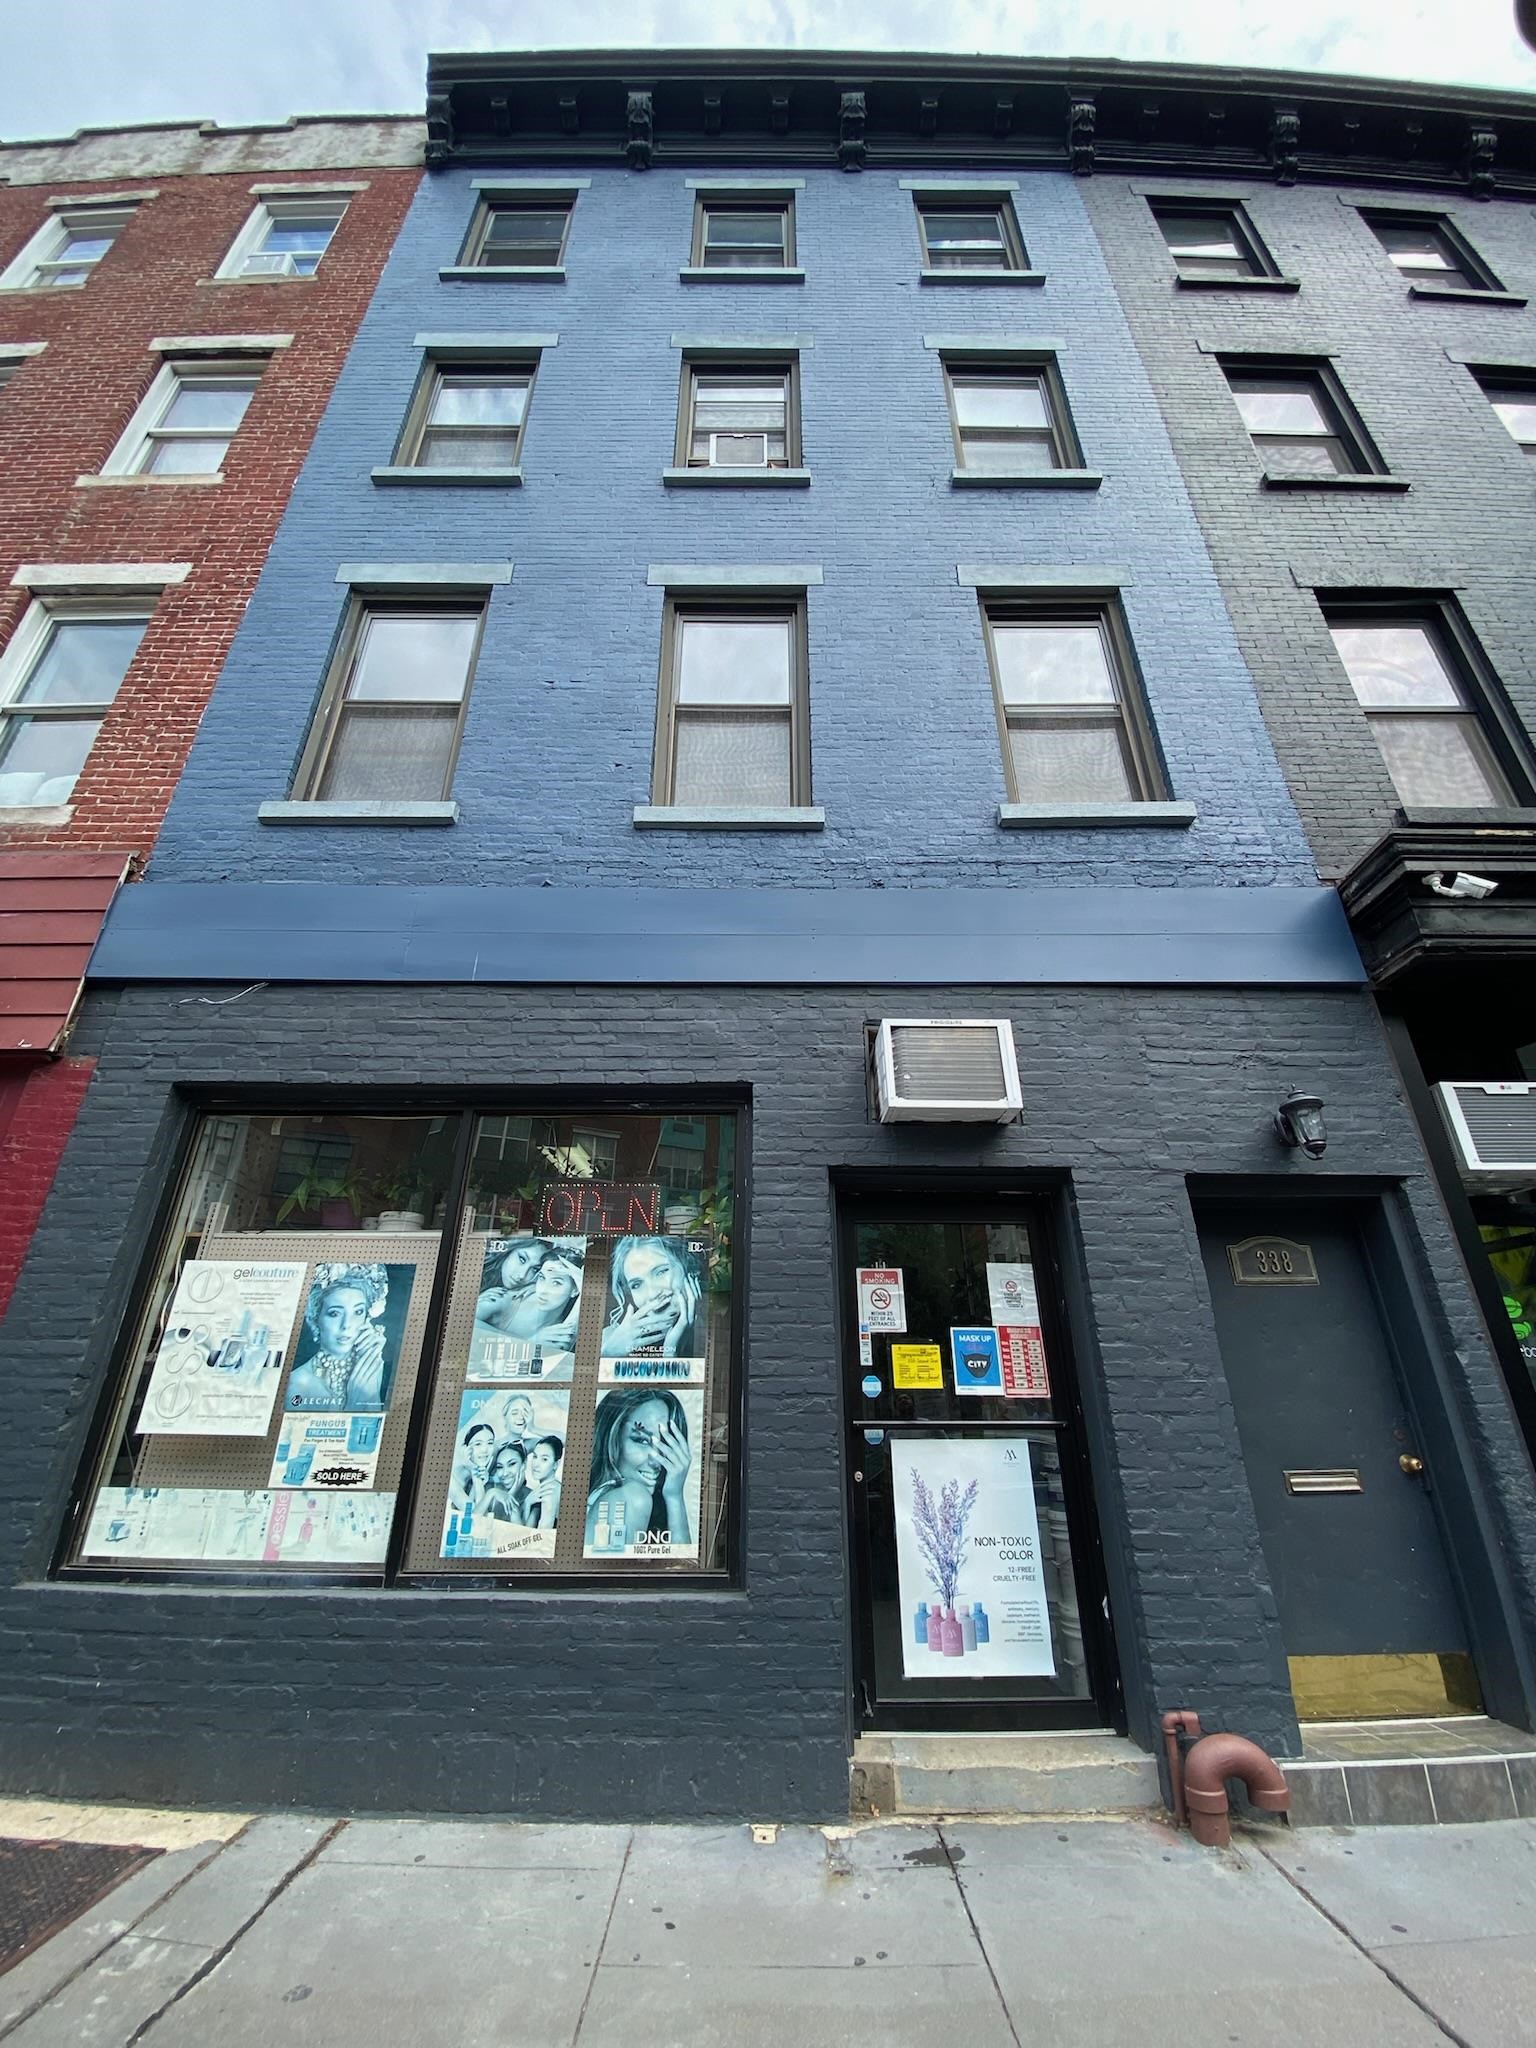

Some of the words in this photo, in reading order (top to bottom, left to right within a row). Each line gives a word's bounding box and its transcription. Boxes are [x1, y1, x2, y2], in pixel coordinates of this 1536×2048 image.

[547, 1190, 656, 1231] OPEN
[1256, 1250, 1293, 1273] 338
[959, 1334, 979, 1343] MASK
[980, 1334, 992, 1343] UP
[967, 1359, 988, 1368] CITY
[309, 1419, 347, 1428] FUNGUS
[316, 1472, 339, 1481] SOLD
[340, 1472, 363, 1481] HERE
[636, 1530, 672, 1544] DND
[974, 1536, 1032, 1547] NON-TOXIC
[497, 1545, 507, 1554] ALL
[507, 1539, 521, 1551] SOAK
[522, 1535, 532, 1546] OFF
[532, 1533, 543, 1542] GEL
[633, 1546, 647, 1554] 100%
[647, 1545, 661, 1554] Pure
[661, 1545, 671, 1554] Gel
[999, 1550, 1034, 1560] COLOR
[992, 1575, 1037, 1583] CRUELTY-FREE
